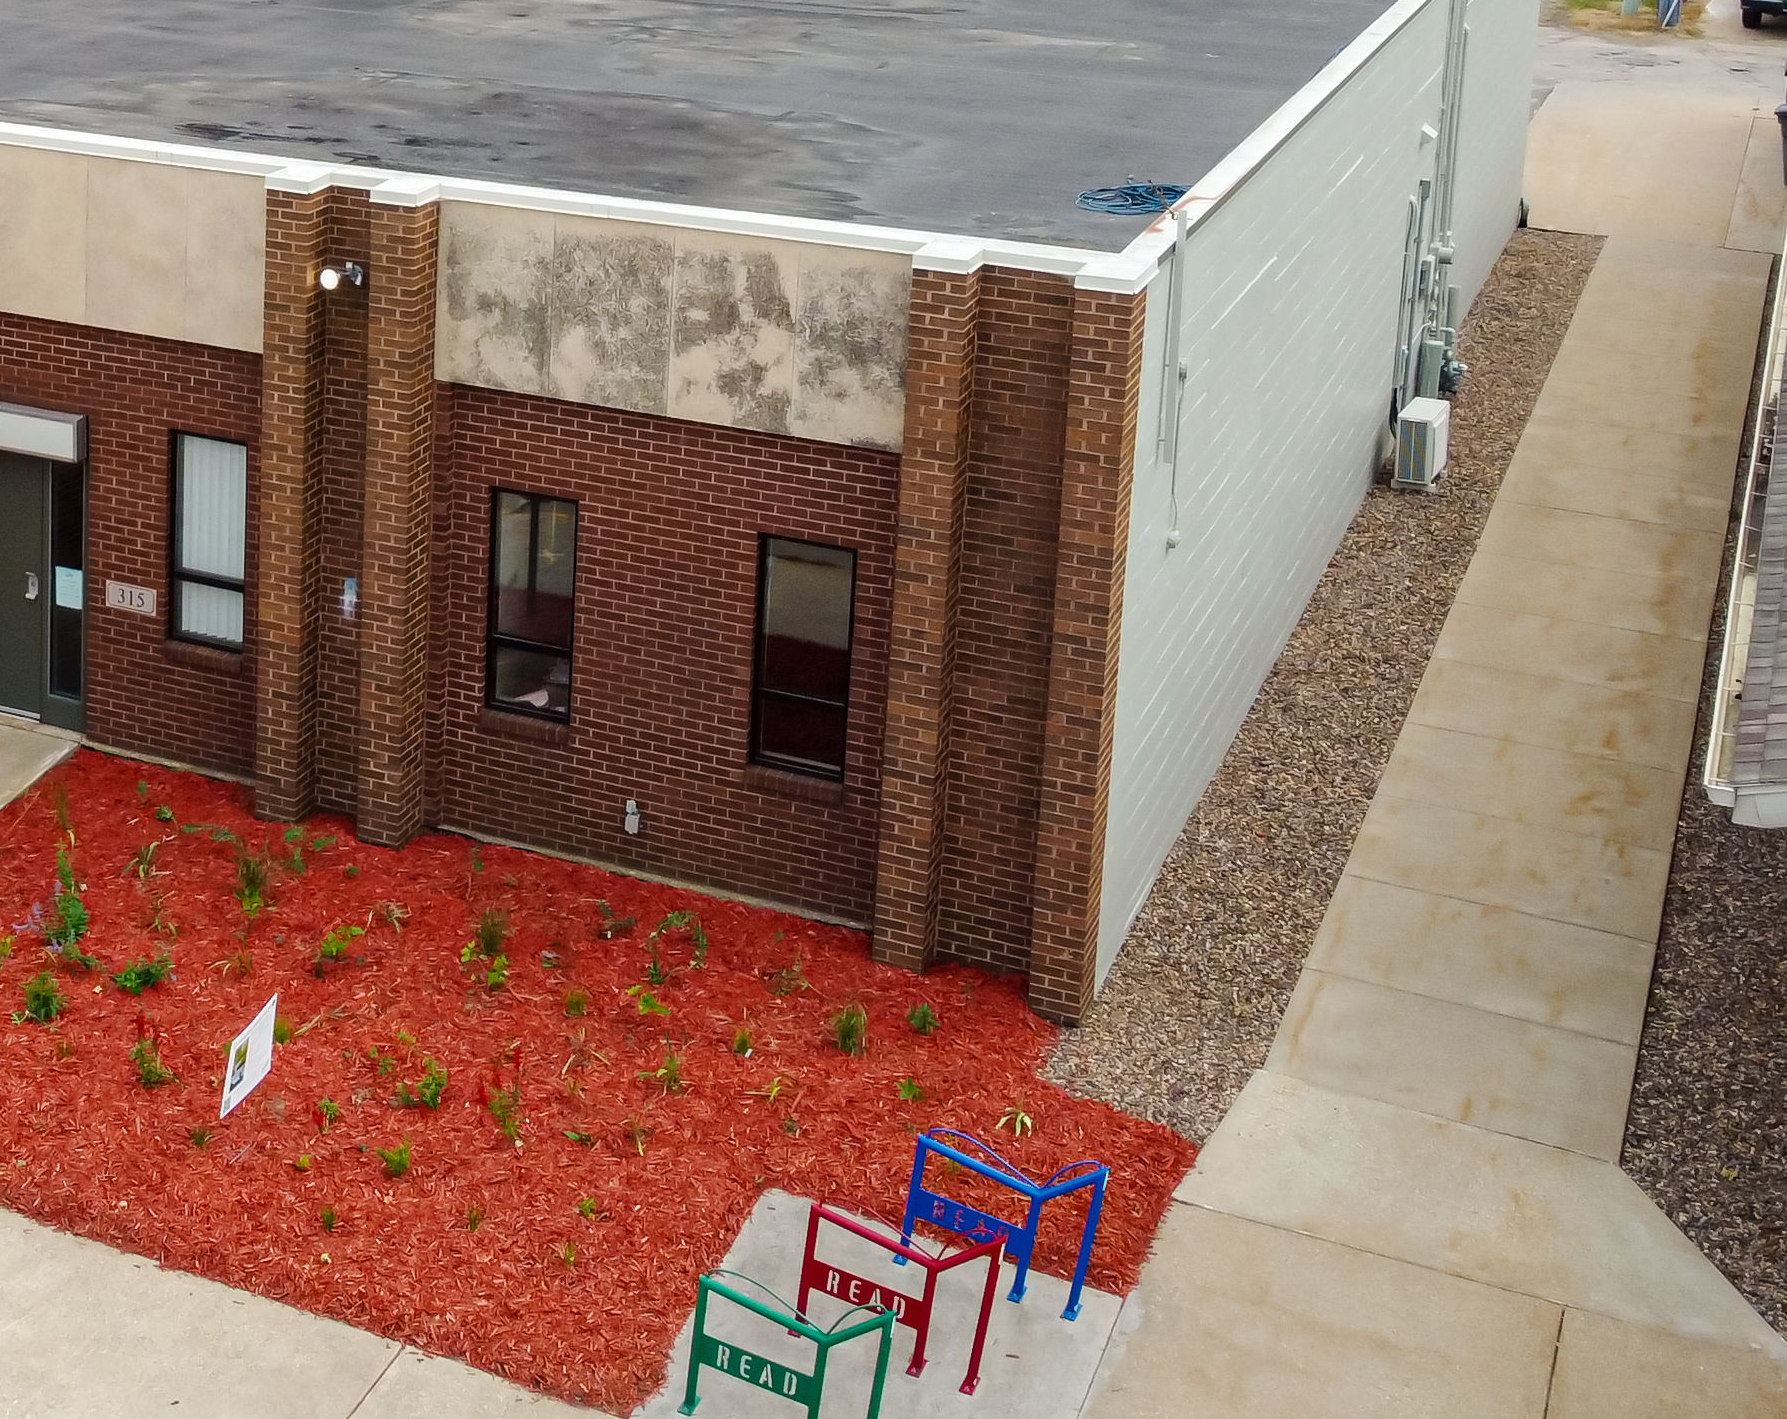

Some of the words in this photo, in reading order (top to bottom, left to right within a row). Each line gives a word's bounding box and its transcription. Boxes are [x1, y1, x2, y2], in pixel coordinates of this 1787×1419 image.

[117, 588, 145, 608] 315
[826, 1269, 906, 1319] READ
[716, 1344, 798, 1396] READ
